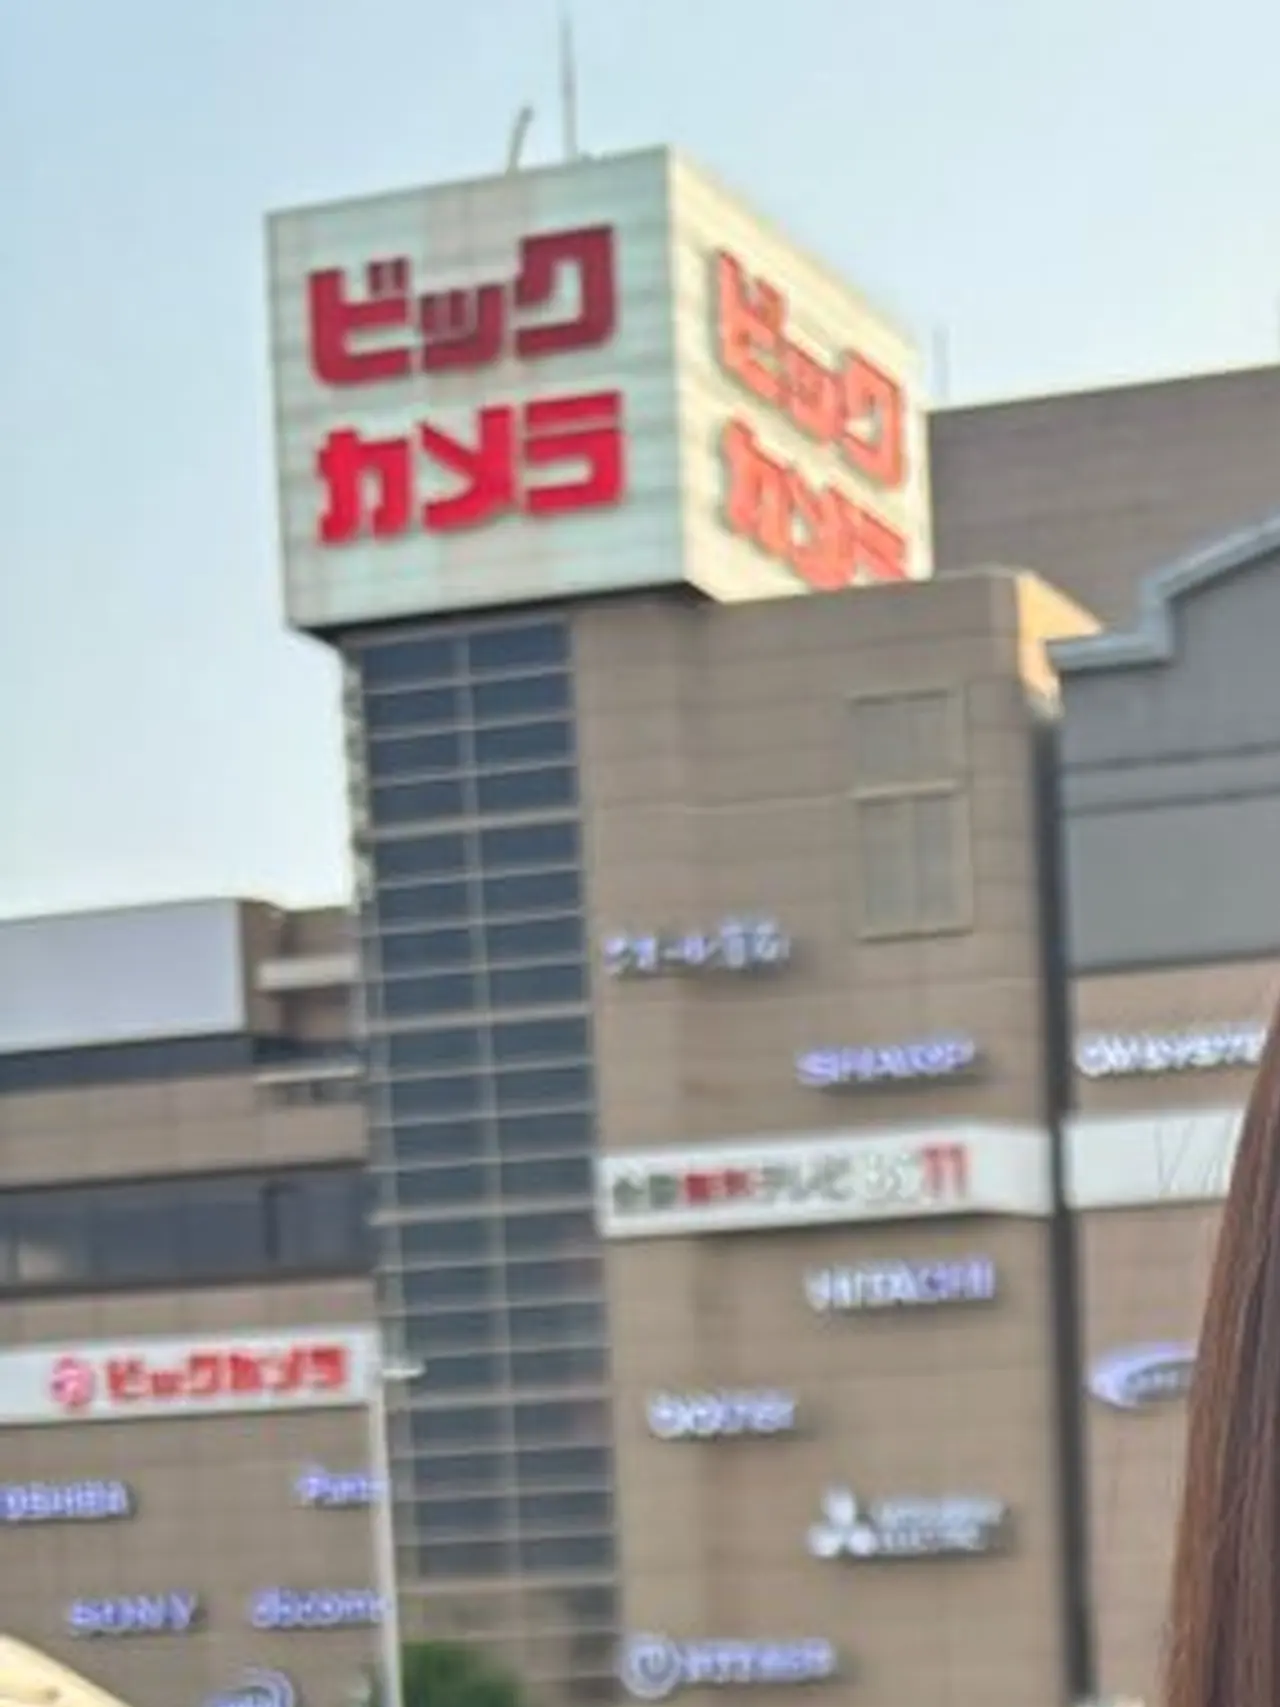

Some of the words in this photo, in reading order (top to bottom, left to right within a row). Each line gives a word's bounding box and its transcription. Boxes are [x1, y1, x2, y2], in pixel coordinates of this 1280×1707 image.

[308, 224, 617, 390] ビック
[717, 250, 904, 491] ビック
[315, 390, 624, 548] カメラ
[722, 418, 908, 592] カメラ
[106, 1343, 350, 1403] ビックカメラ
